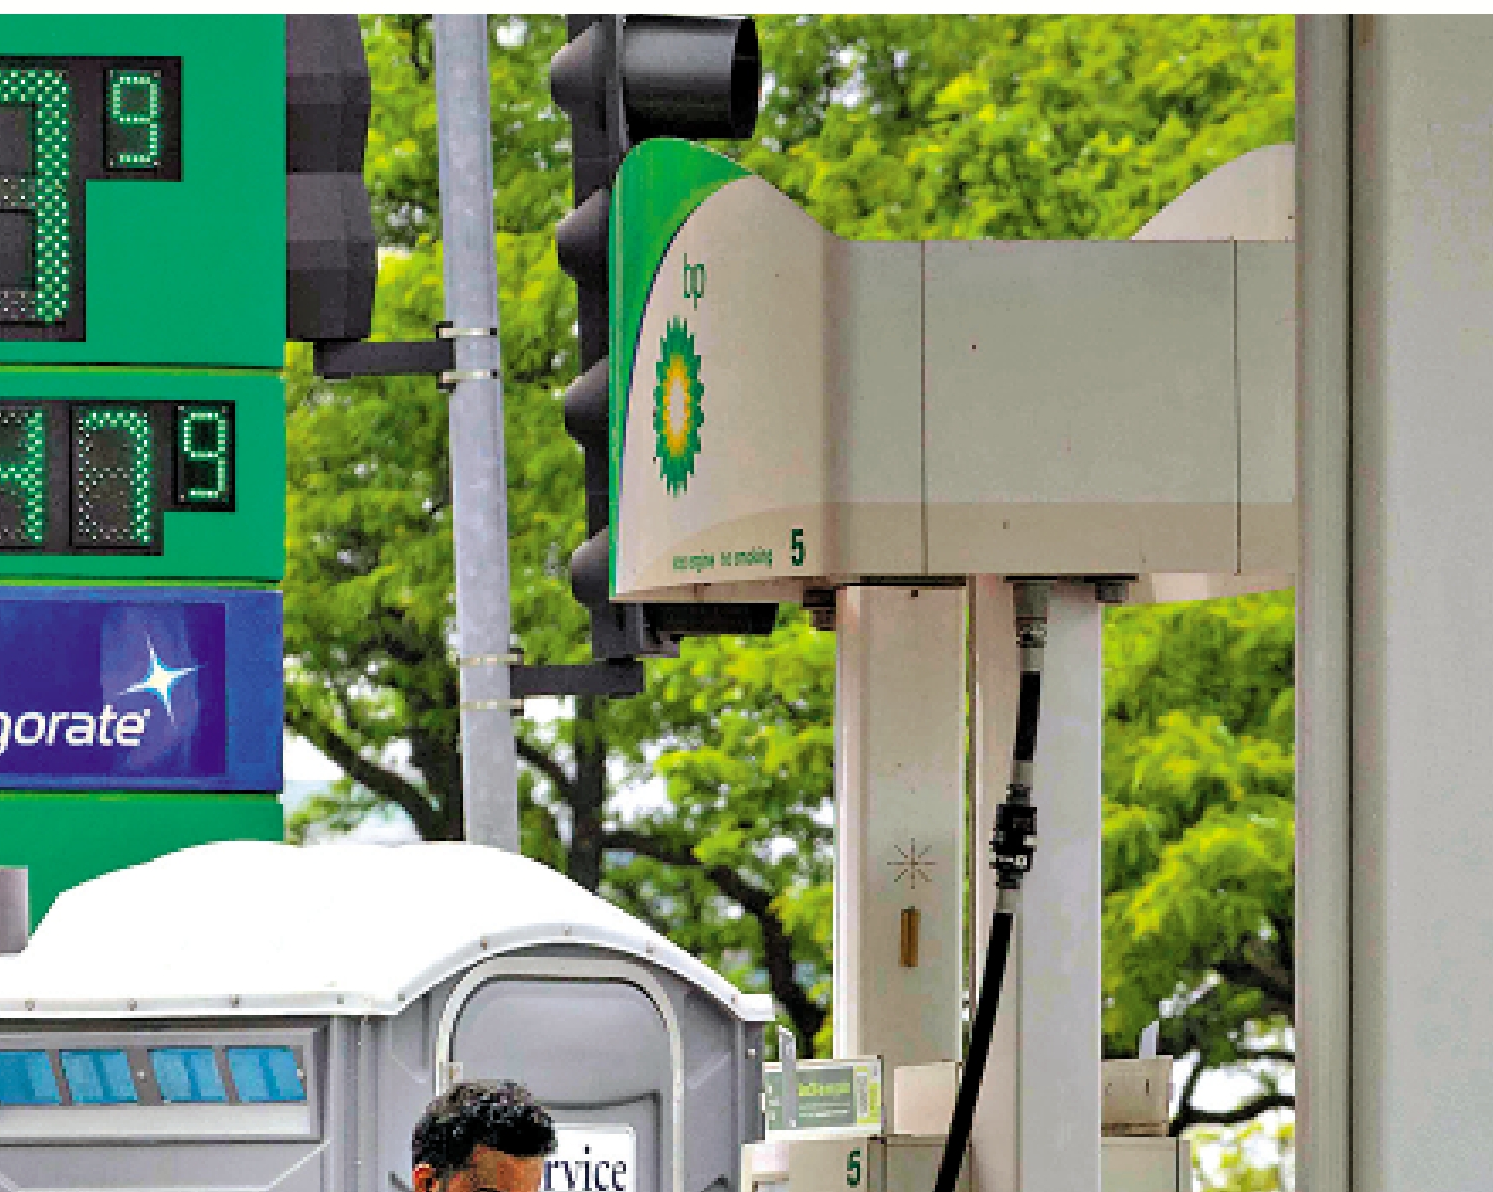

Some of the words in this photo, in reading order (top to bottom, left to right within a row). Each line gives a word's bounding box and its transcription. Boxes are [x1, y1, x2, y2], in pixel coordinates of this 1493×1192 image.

[682, 253, 706, 311] bp
[791, 528, 806, 567] 5
[543, 1143, 628, 1192] rvice
[846, 1148, 861, 1188] 5
